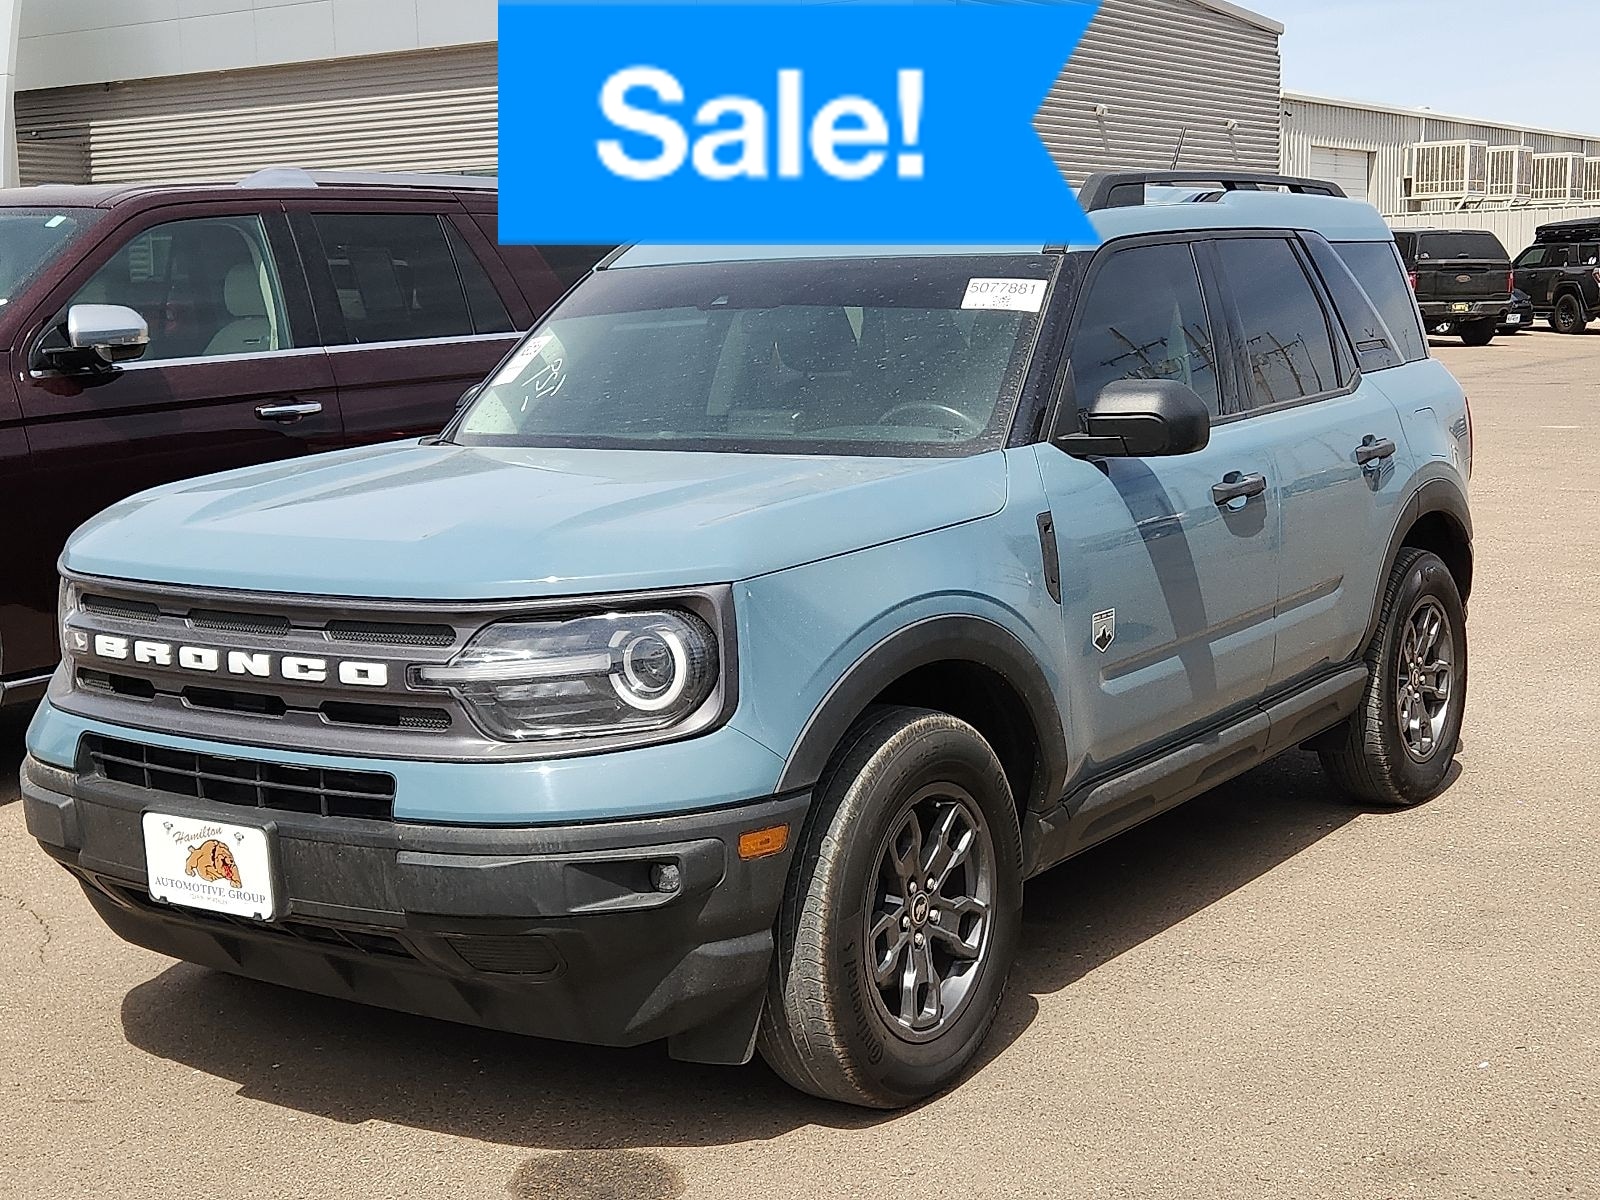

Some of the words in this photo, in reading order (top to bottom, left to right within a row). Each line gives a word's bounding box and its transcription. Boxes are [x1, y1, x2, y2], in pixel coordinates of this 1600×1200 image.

[969, 282, 1036, 294] 5077881
[94, 633, 388, 686] BRONCO
[173, 825, 223, 845] Hamilton
[155, 876, 226, 898] AUTOMOTIVE
[228, 889, 266, 904] GROUP
